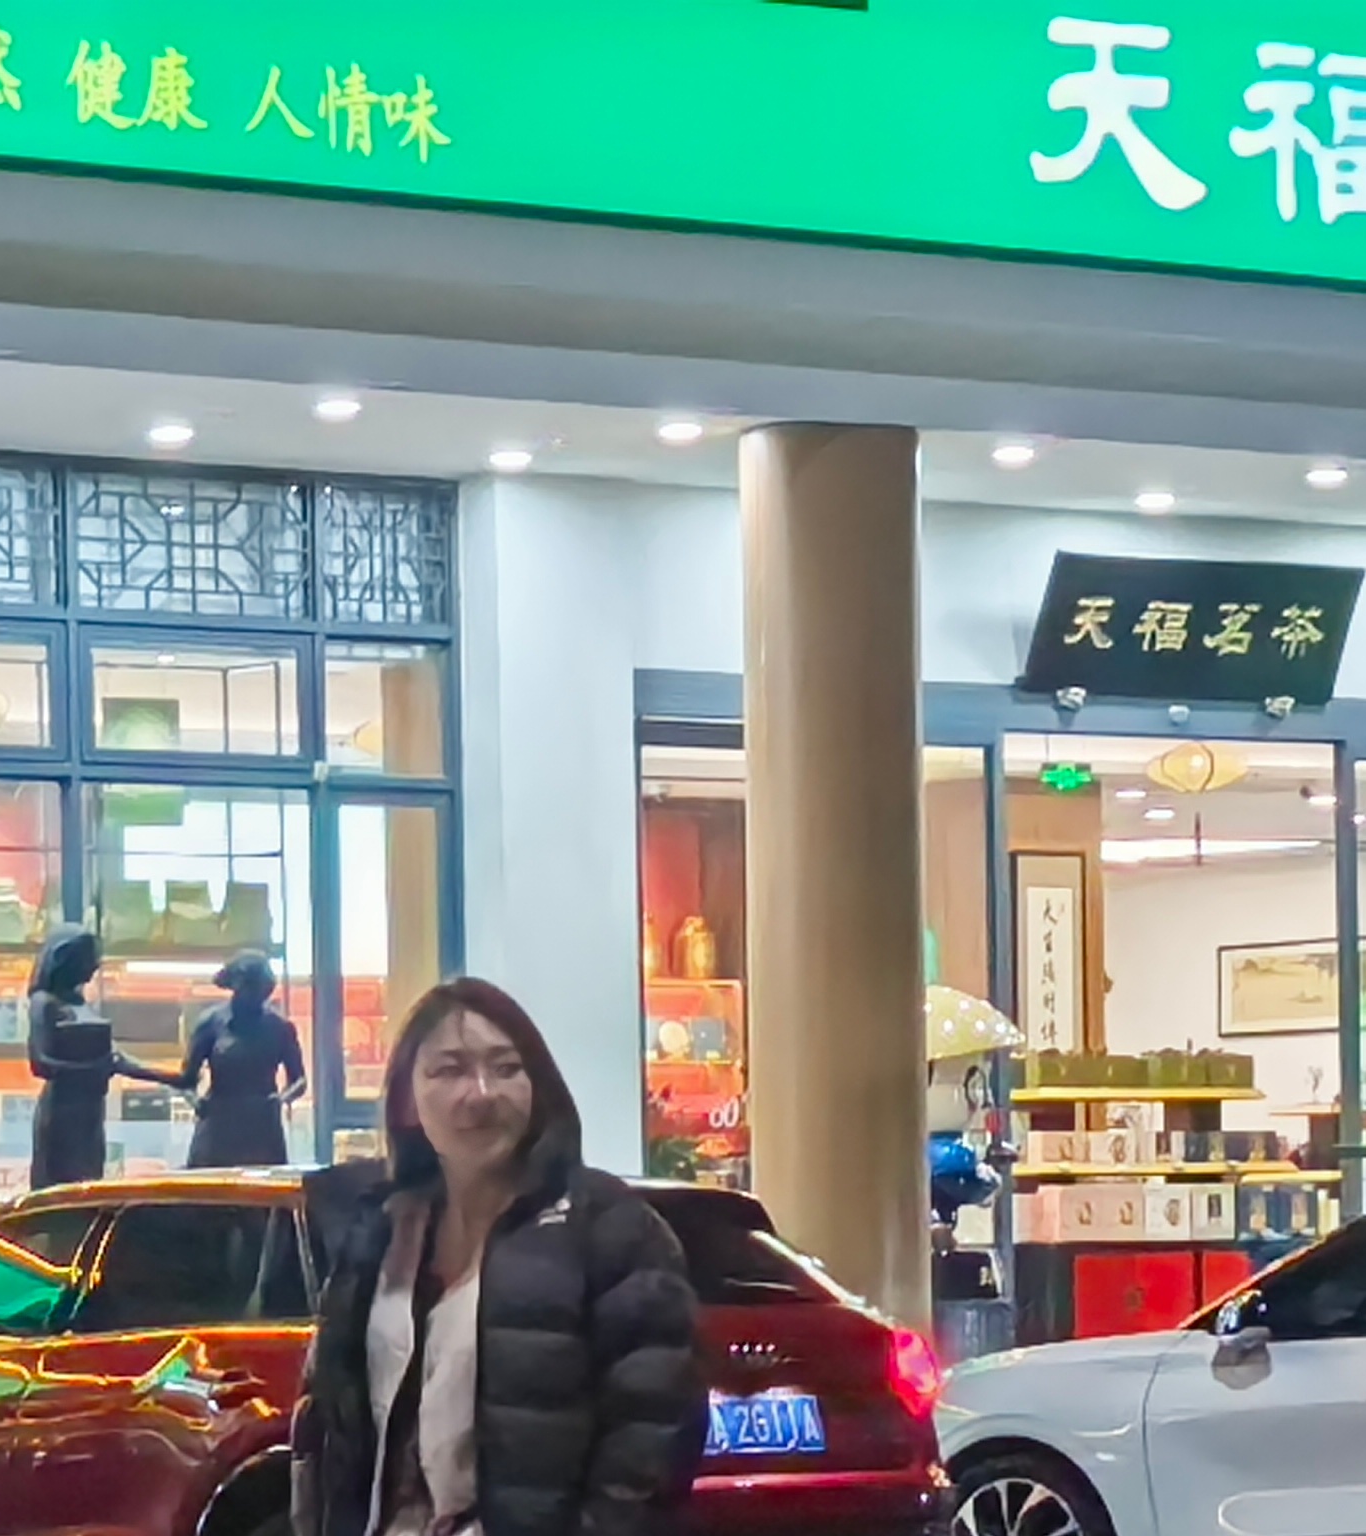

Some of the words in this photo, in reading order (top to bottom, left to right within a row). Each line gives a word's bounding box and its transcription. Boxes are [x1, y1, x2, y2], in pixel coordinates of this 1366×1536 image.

[65, 40, 208, 130] 健康
[245, 61, 452, 164] 人情味
[1063, 596, 1325, 661] 天福茗茶
